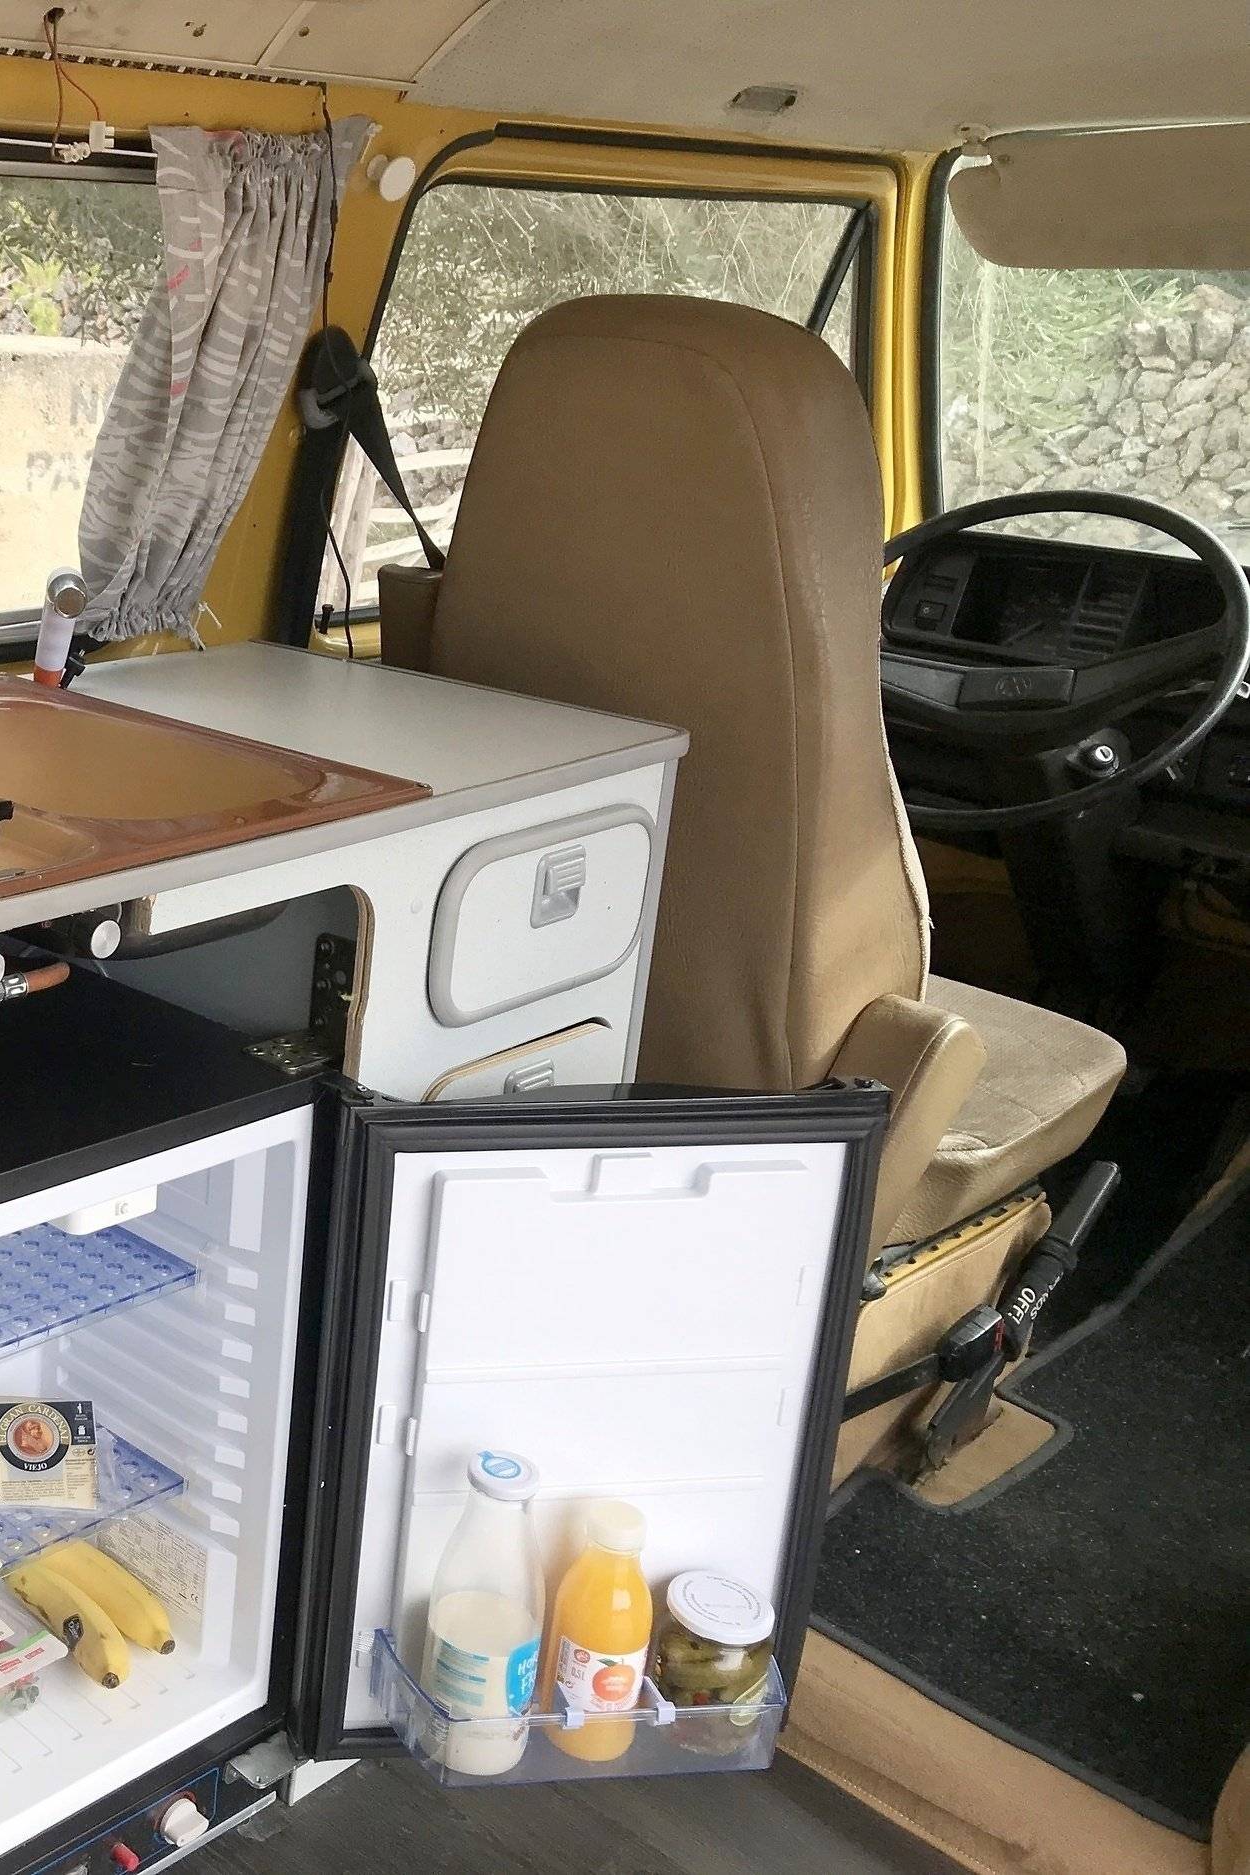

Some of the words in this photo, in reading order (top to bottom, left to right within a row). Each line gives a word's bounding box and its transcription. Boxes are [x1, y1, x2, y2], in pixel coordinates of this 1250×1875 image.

[27, 451, 92, 491] PA
[0, 1407, 25, 1434] GRAN
[28, 1404, 69, 1442] CARDENAL
[23, 1462, 48, 1471] VIEJO
